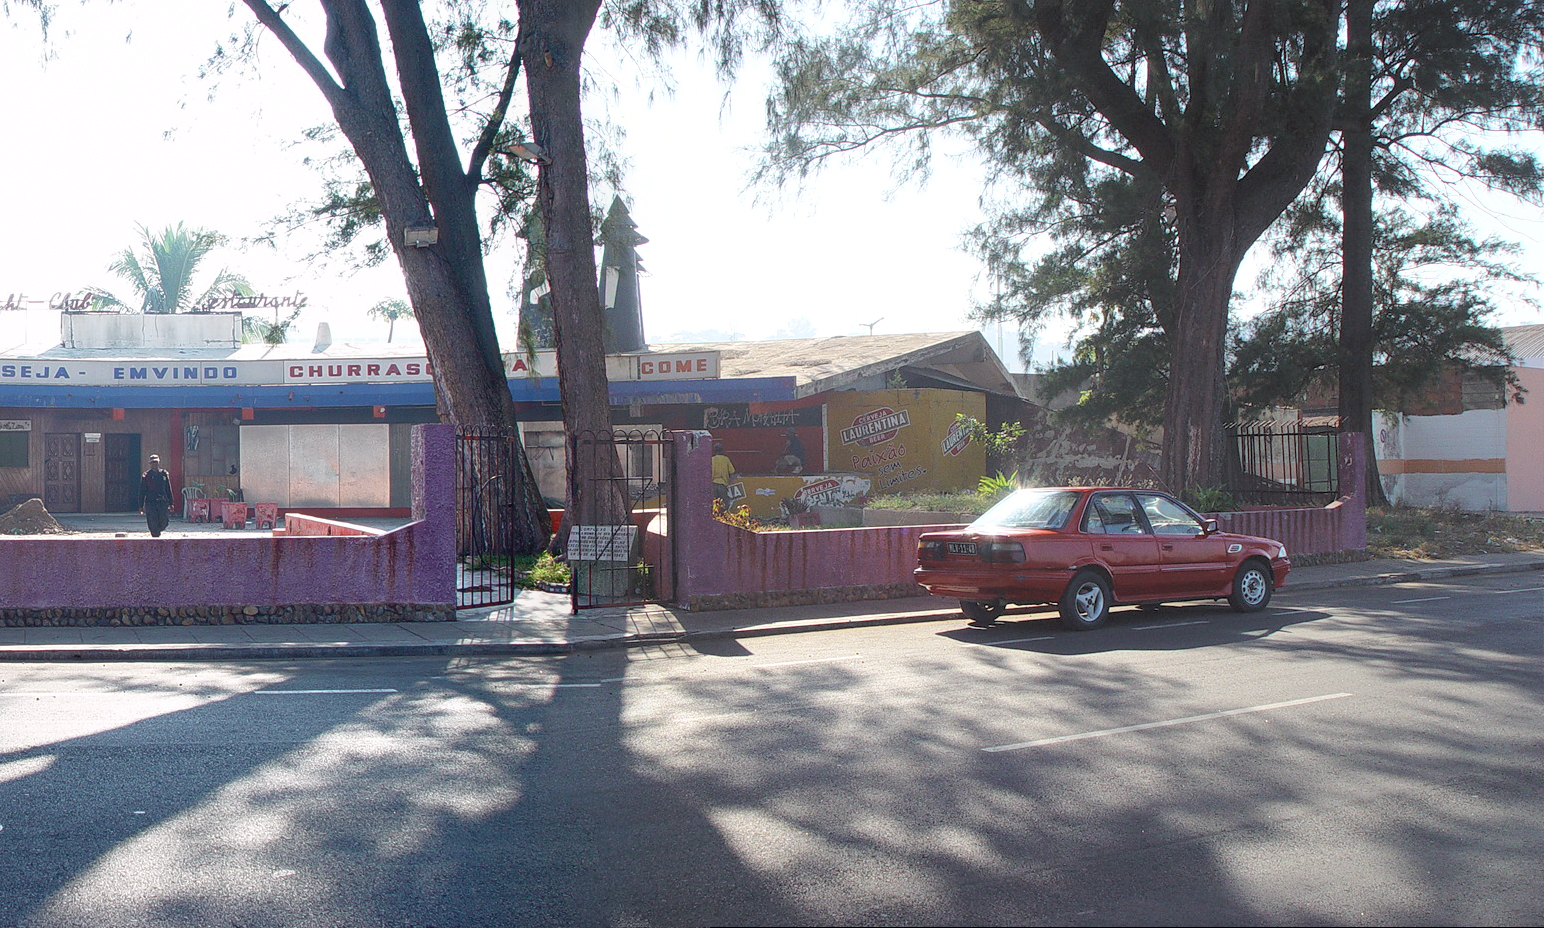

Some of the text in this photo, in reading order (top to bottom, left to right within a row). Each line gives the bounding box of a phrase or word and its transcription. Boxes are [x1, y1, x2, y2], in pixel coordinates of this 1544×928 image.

[1, 364, 70, 379] SEJA
[858, 410, 887, 424] CERVEJA
[842, 413, 906, 442] LAURENTINA
[869, 433, 886, 444] BEER
[852, 443, 906, 470] Paixão
[878, 461, 901, 477] sem
